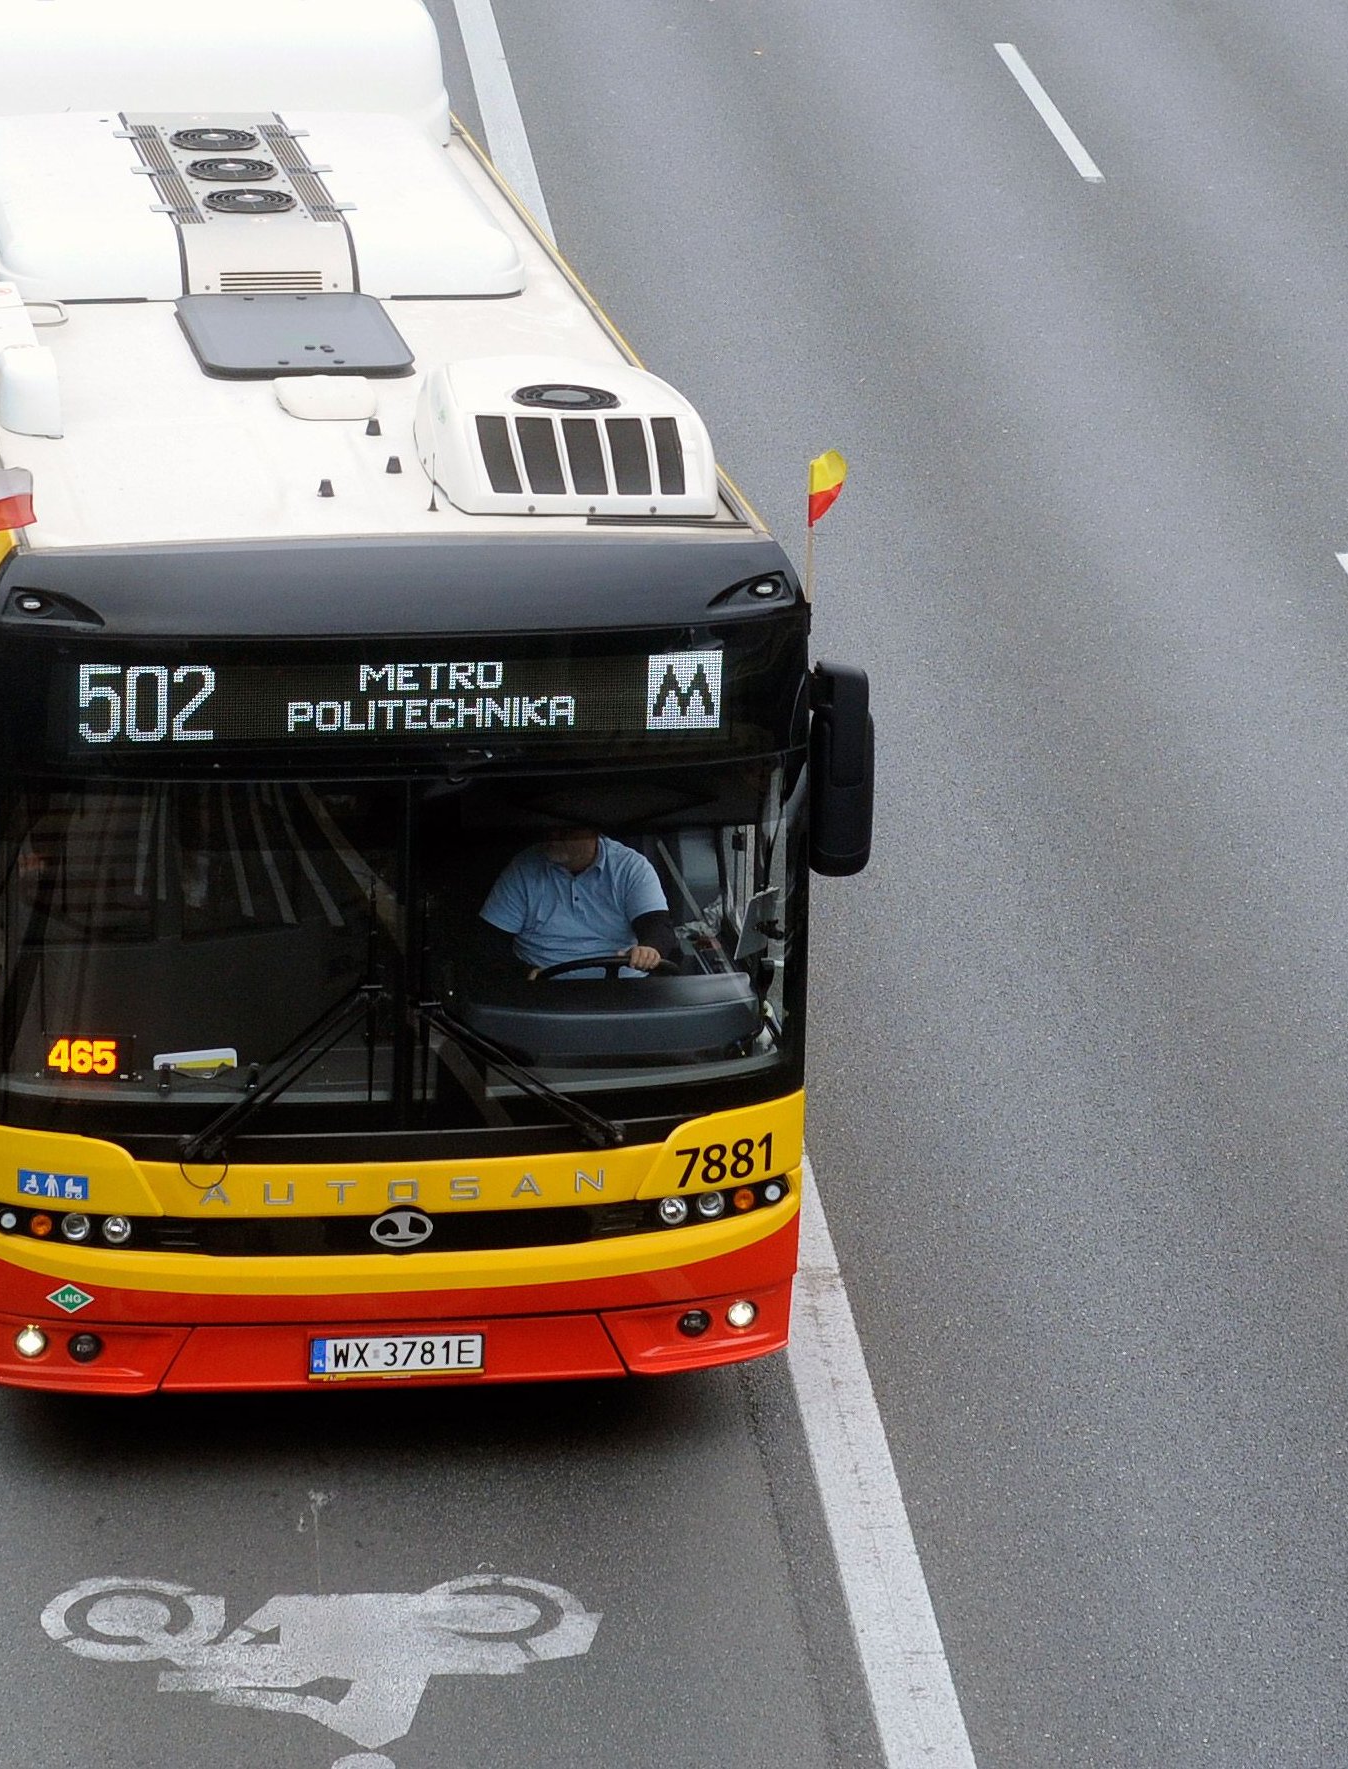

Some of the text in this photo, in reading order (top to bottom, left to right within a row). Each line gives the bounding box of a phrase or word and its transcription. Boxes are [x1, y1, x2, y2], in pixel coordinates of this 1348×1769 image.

[359, 661, 503, 691] METRO
[79, 664, 215, 743] 502
[287, 694, 575, 732] POLITECHNIKA
[48, 1039, 117, 1074] 465
[675, 1132, 774, 1188] 7881
[199, 1168, 605, 1206] AUTOSAN
[57, 1293, 82, 1304] LNG
[333, 1339, 475, 1368] WX 3781E
